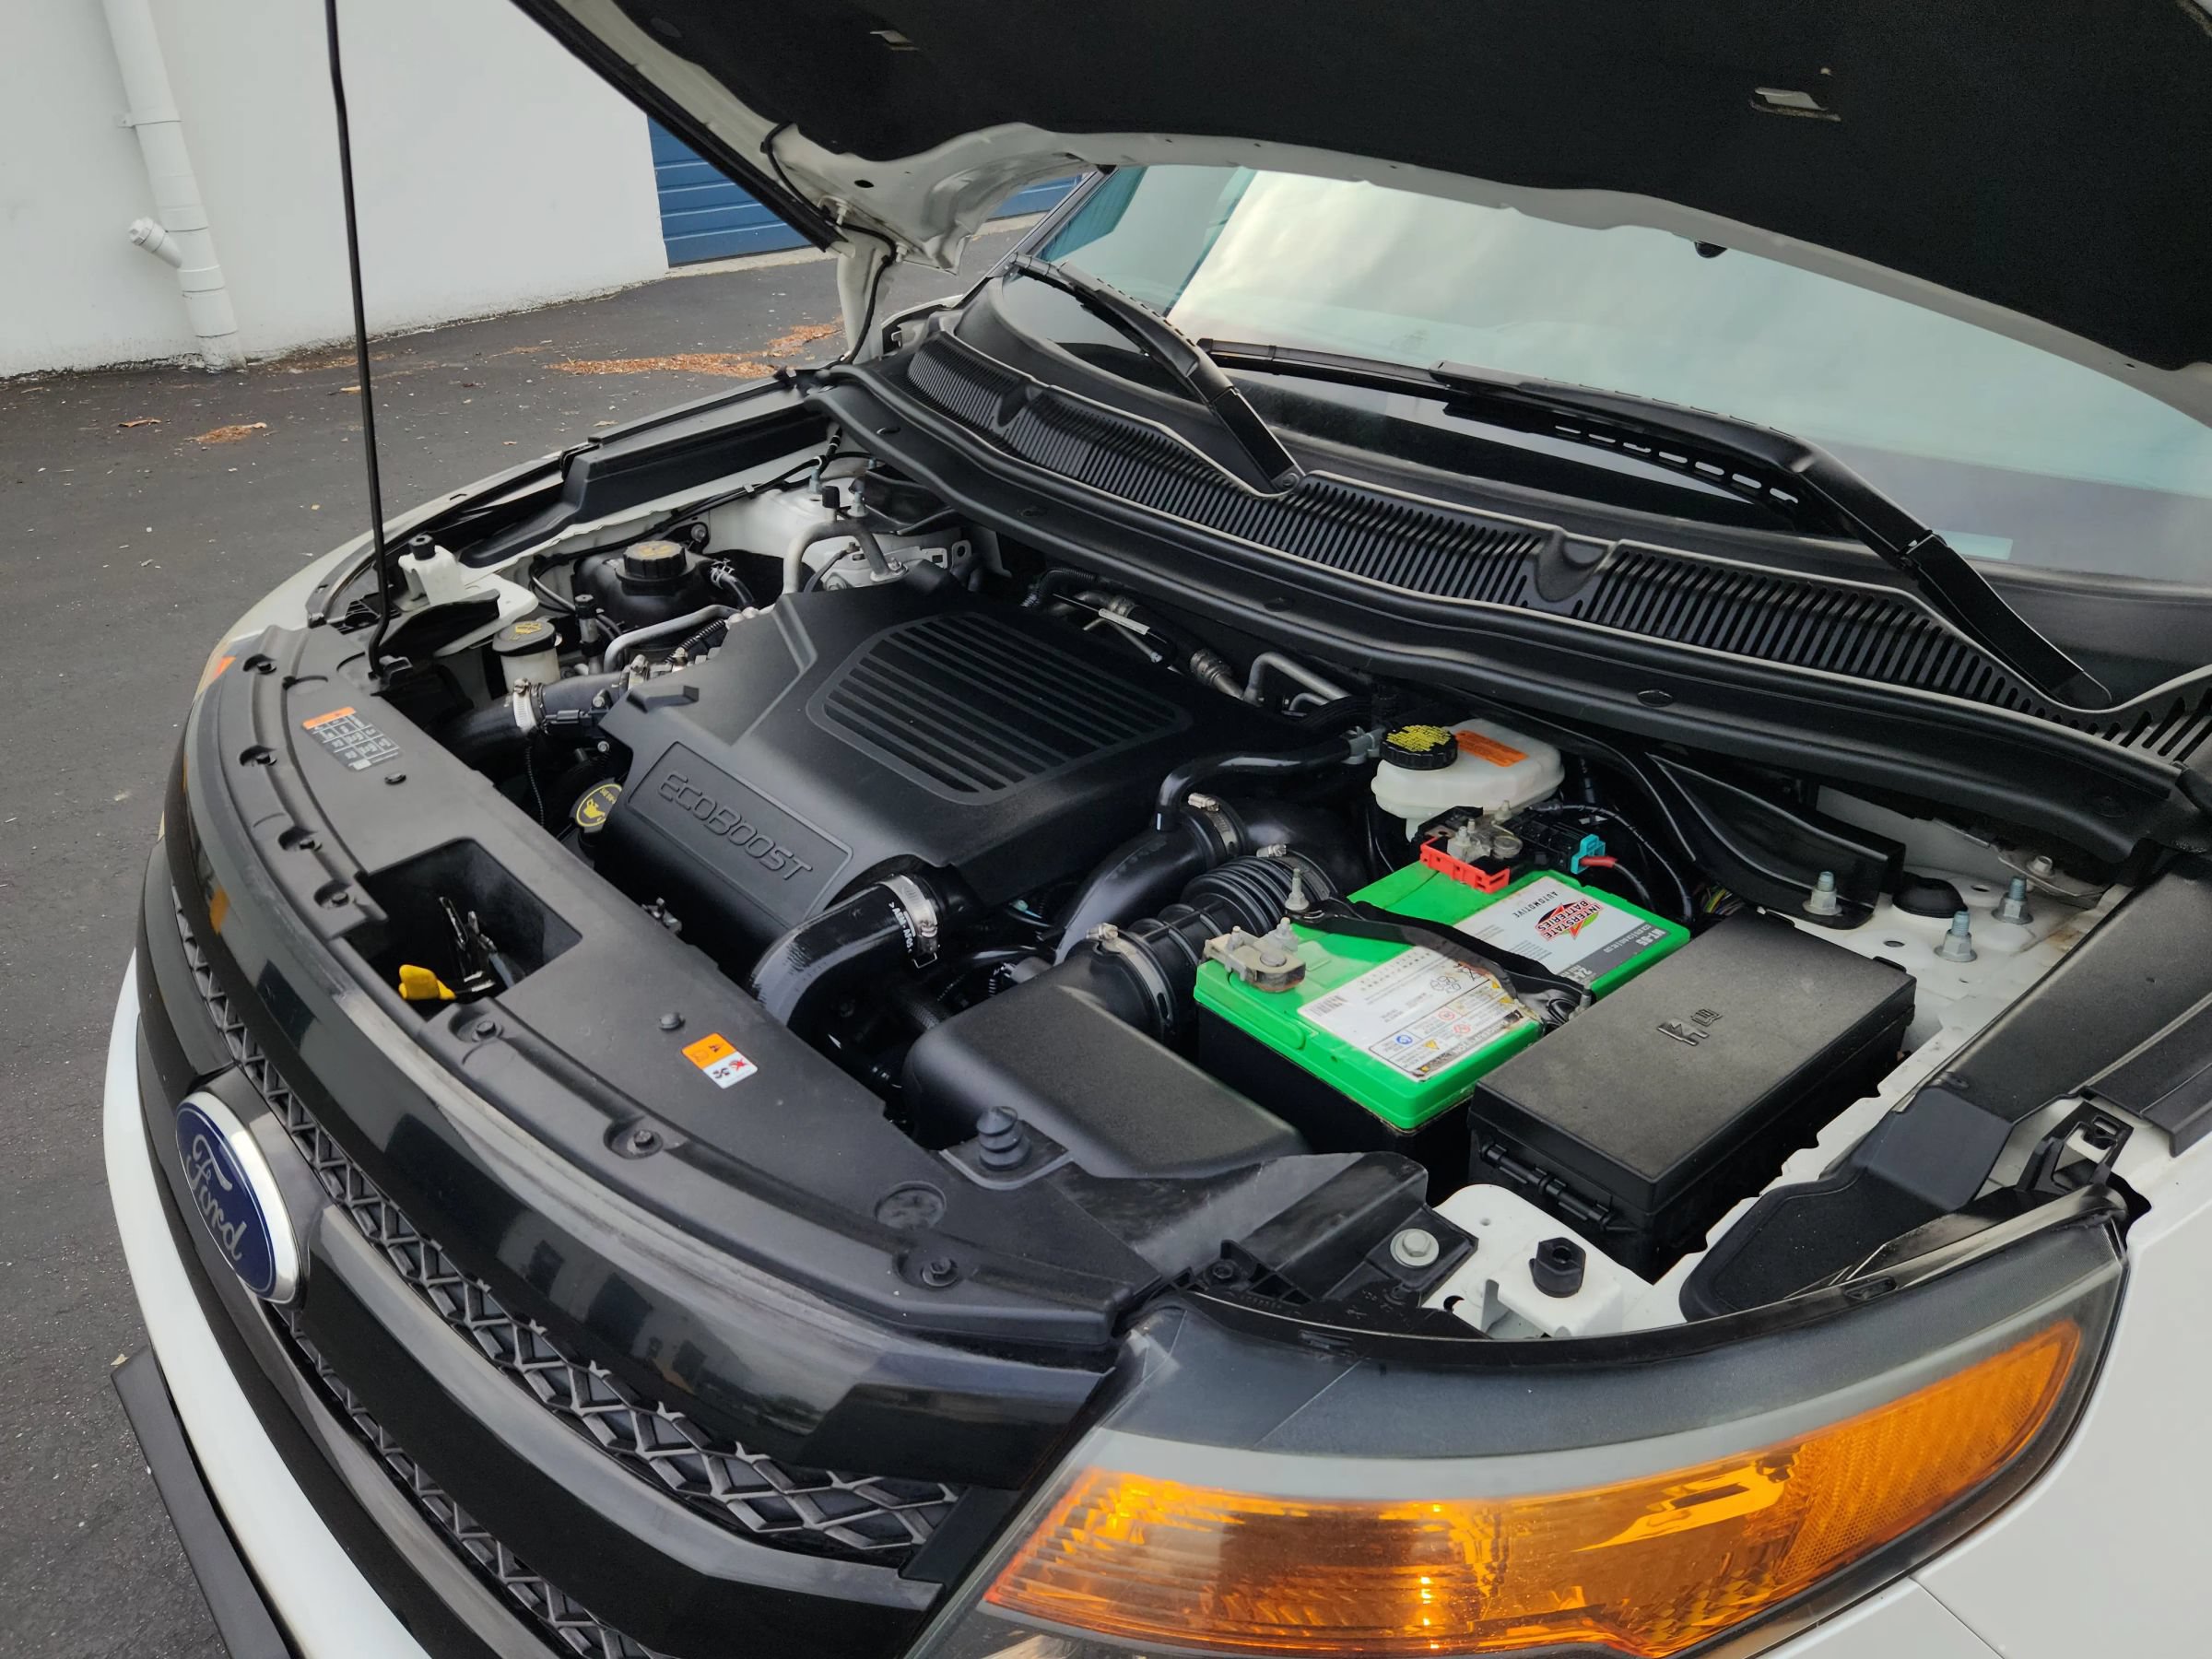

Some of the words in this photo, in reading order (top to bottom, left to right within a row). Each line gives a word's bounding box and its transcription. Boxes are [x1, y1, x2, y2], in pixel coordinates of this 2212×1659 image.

[658, 771, 813, 880] ECOBOOST
[1512, 891, 1559, 918] AUTOMOTIVE
[1537, 900, 1589, 931] BATTERIES
[1544, 904, 1600, 938] INTERSTATE
[186, 1134, 247, 1261] Ford
